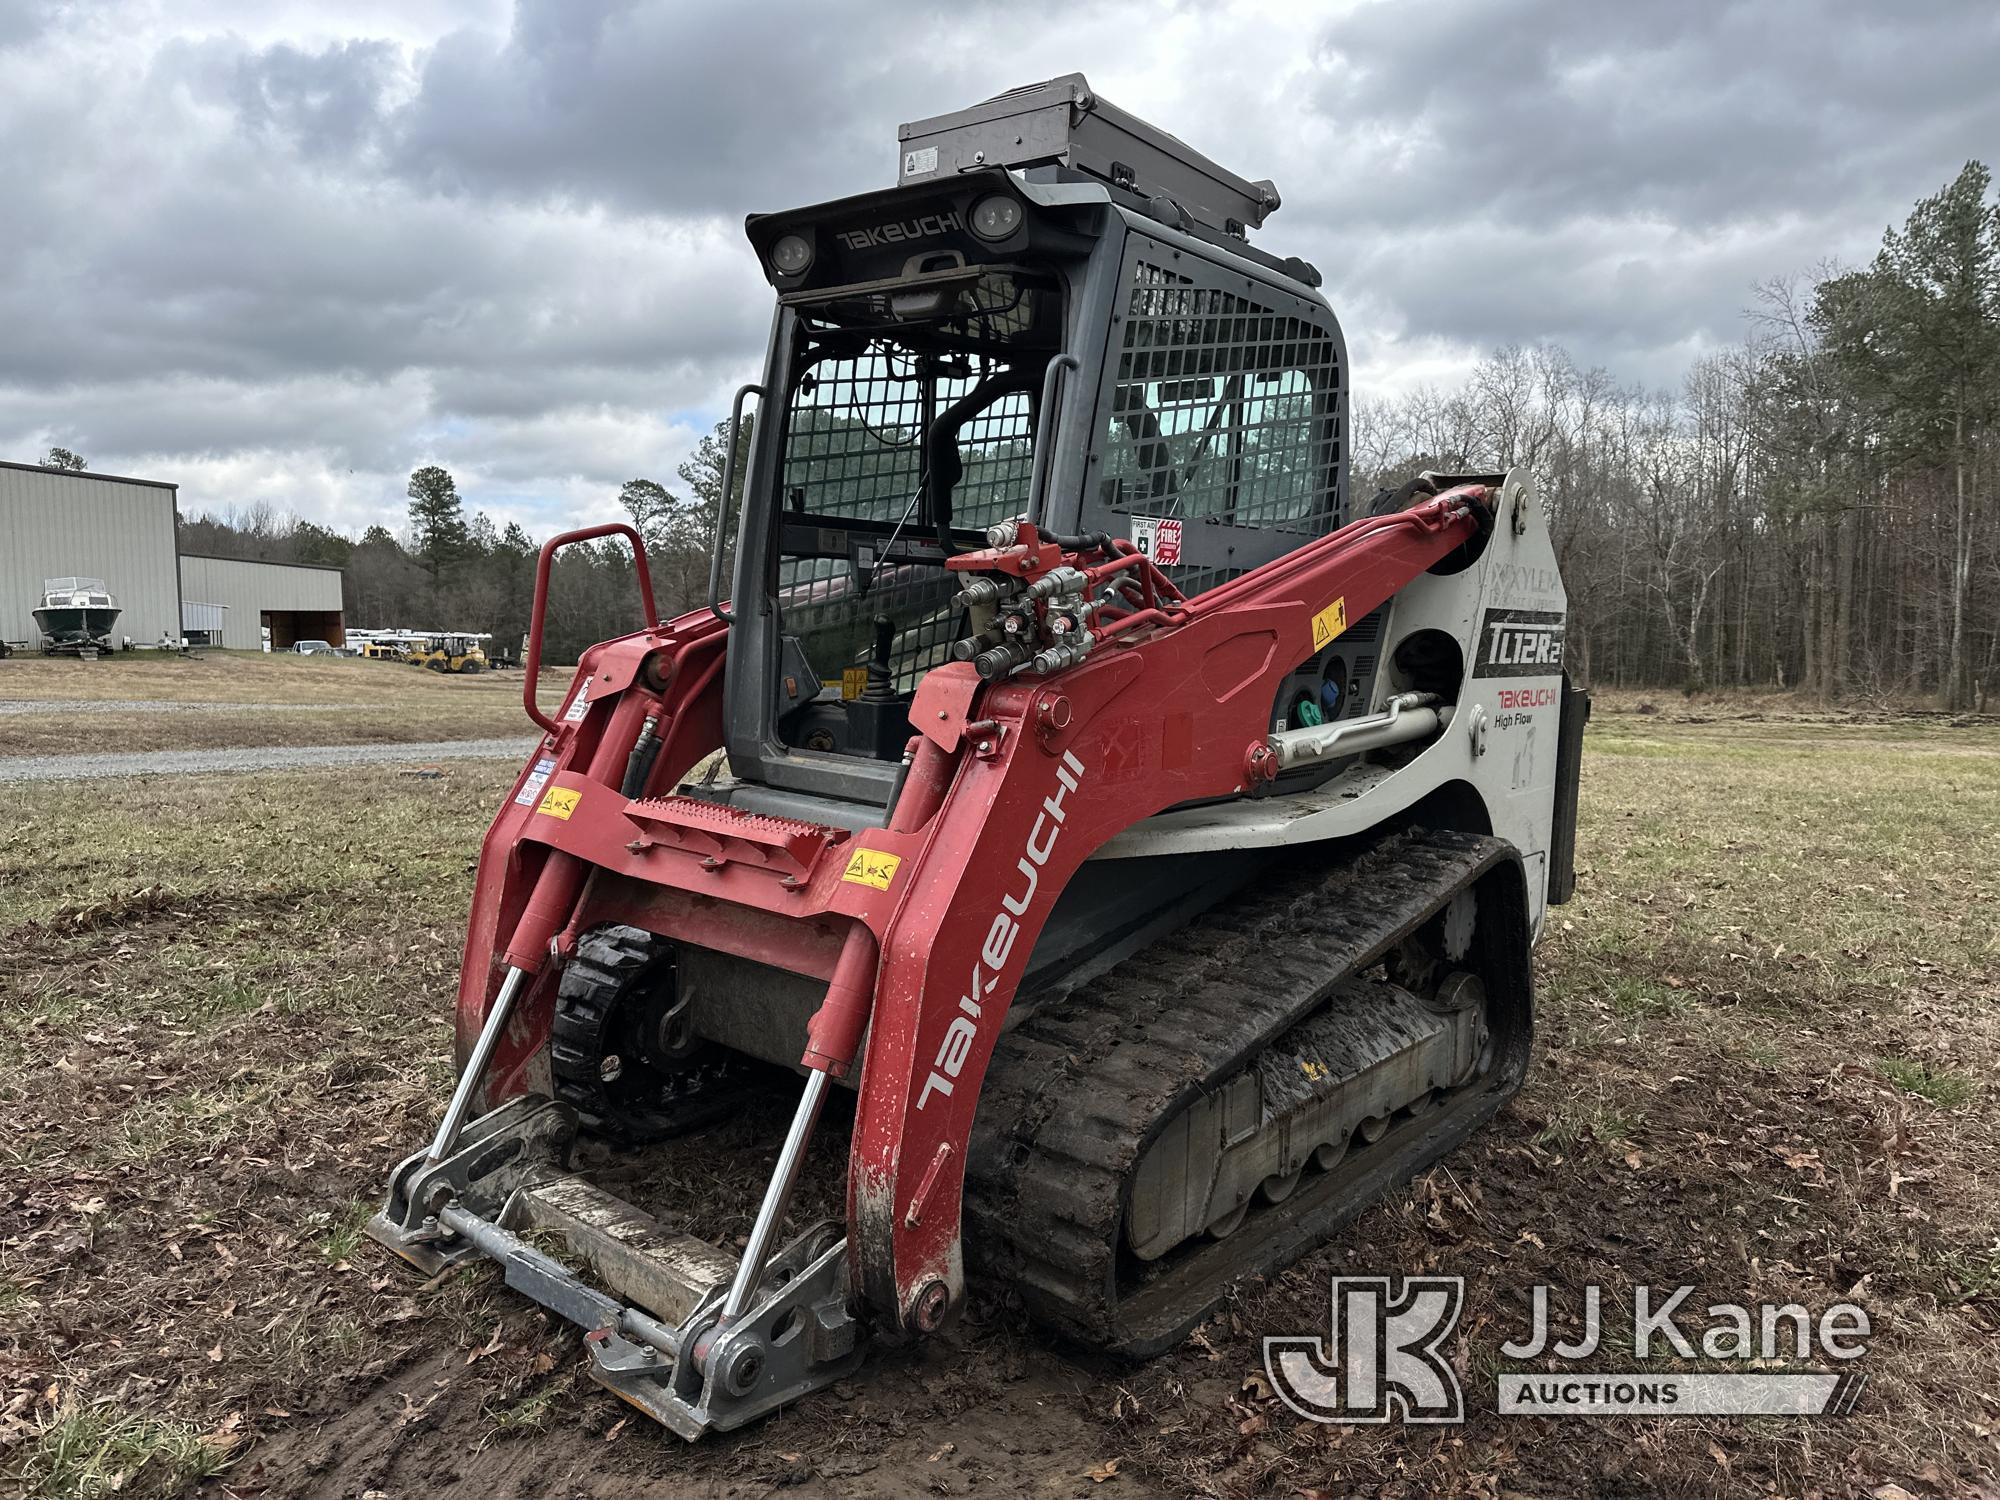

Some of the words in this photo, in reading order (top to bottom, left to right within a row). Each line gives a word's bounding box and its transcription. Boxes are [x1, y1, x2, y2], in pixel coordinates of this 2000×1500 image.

[1160, 528, 1177, 543] FIRE
[1494, 714, 1513, 730] High
[1514, 713, 1533, 726] Flow
